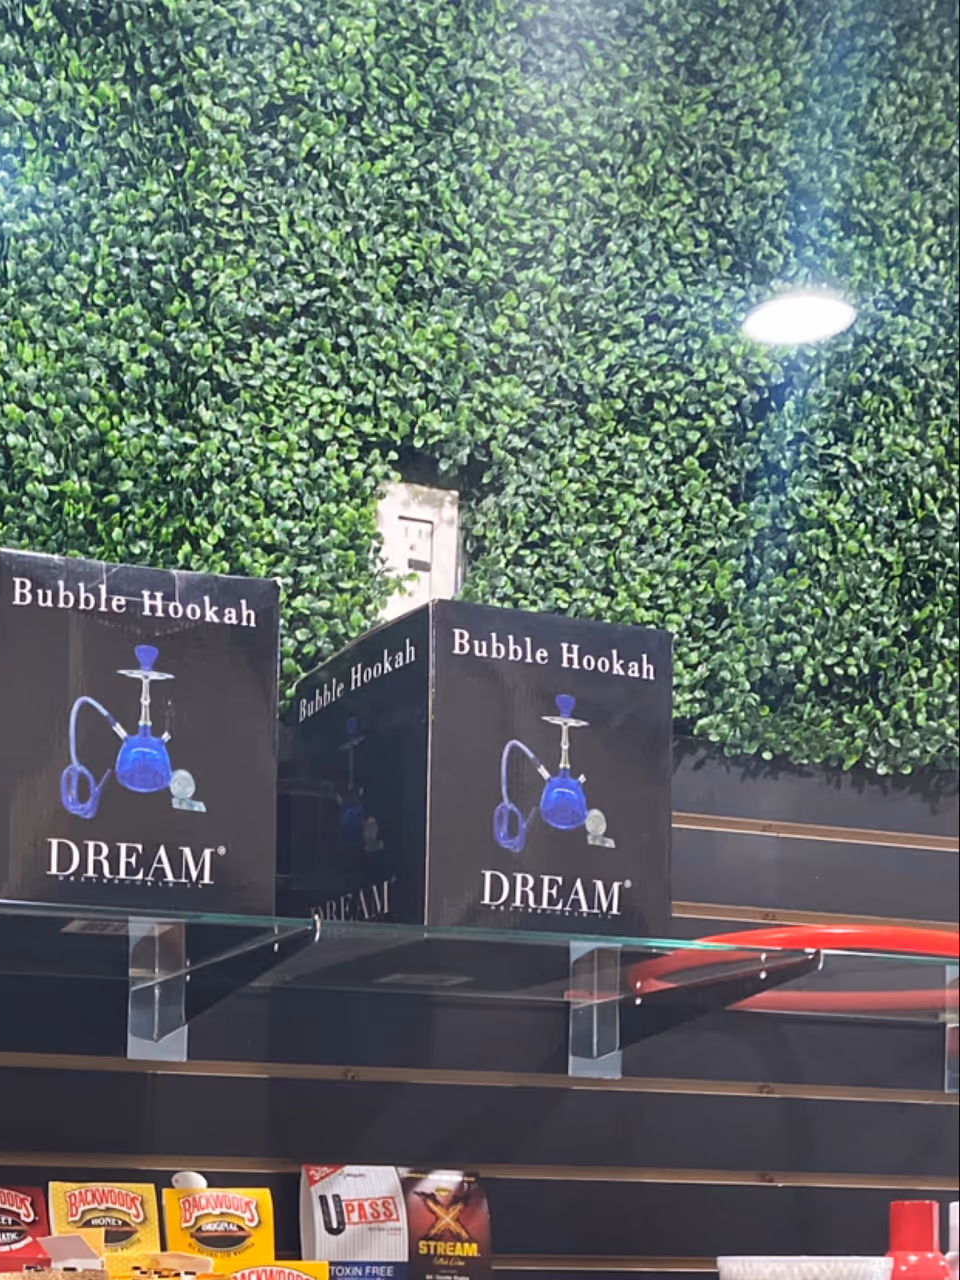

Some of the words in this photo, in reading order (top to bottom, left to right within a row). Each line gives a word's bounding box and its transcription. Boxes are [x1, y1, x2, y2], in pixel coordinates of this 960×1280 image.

[12, 577, 127, 613] Bubble
[142, 590, 257, 627] Hookah
[453, 629, 549, 665] Bubble
[560, 643, 656, 681] Hookah
[299, 676, 344, 723] Bubble
[350, 638, 416, 692] Hookah
[66, 1187, 143, 1222] BACKWOODS
[180, 1192, 259, 1228] BACKWOODS
